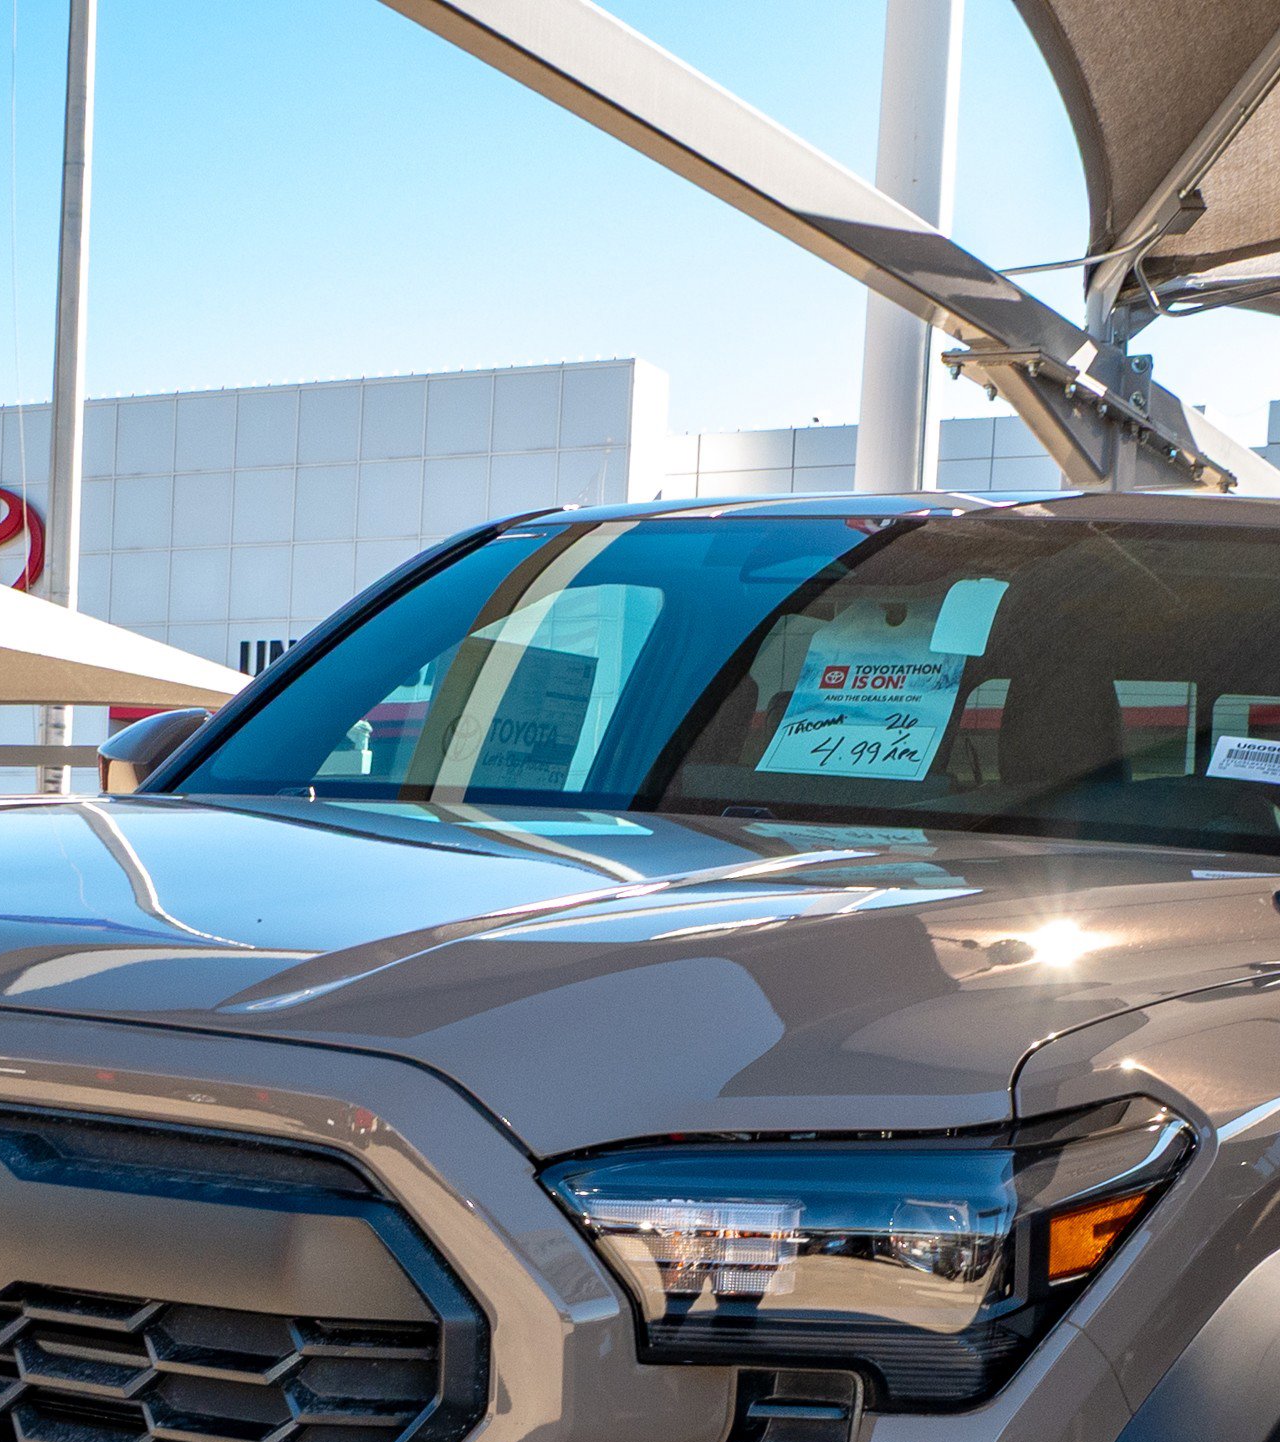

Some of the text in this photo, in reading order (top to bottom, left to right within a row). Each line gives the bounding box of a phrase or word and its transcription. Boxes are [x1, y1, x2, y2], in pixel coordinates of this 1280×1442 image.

[241, 640, 298, 676] U
[855, 664, 942, 675] TOYOTATHON
[851, 676, 906, 689] IS ON!
[489, 717, 558, 748] TOYOTA
